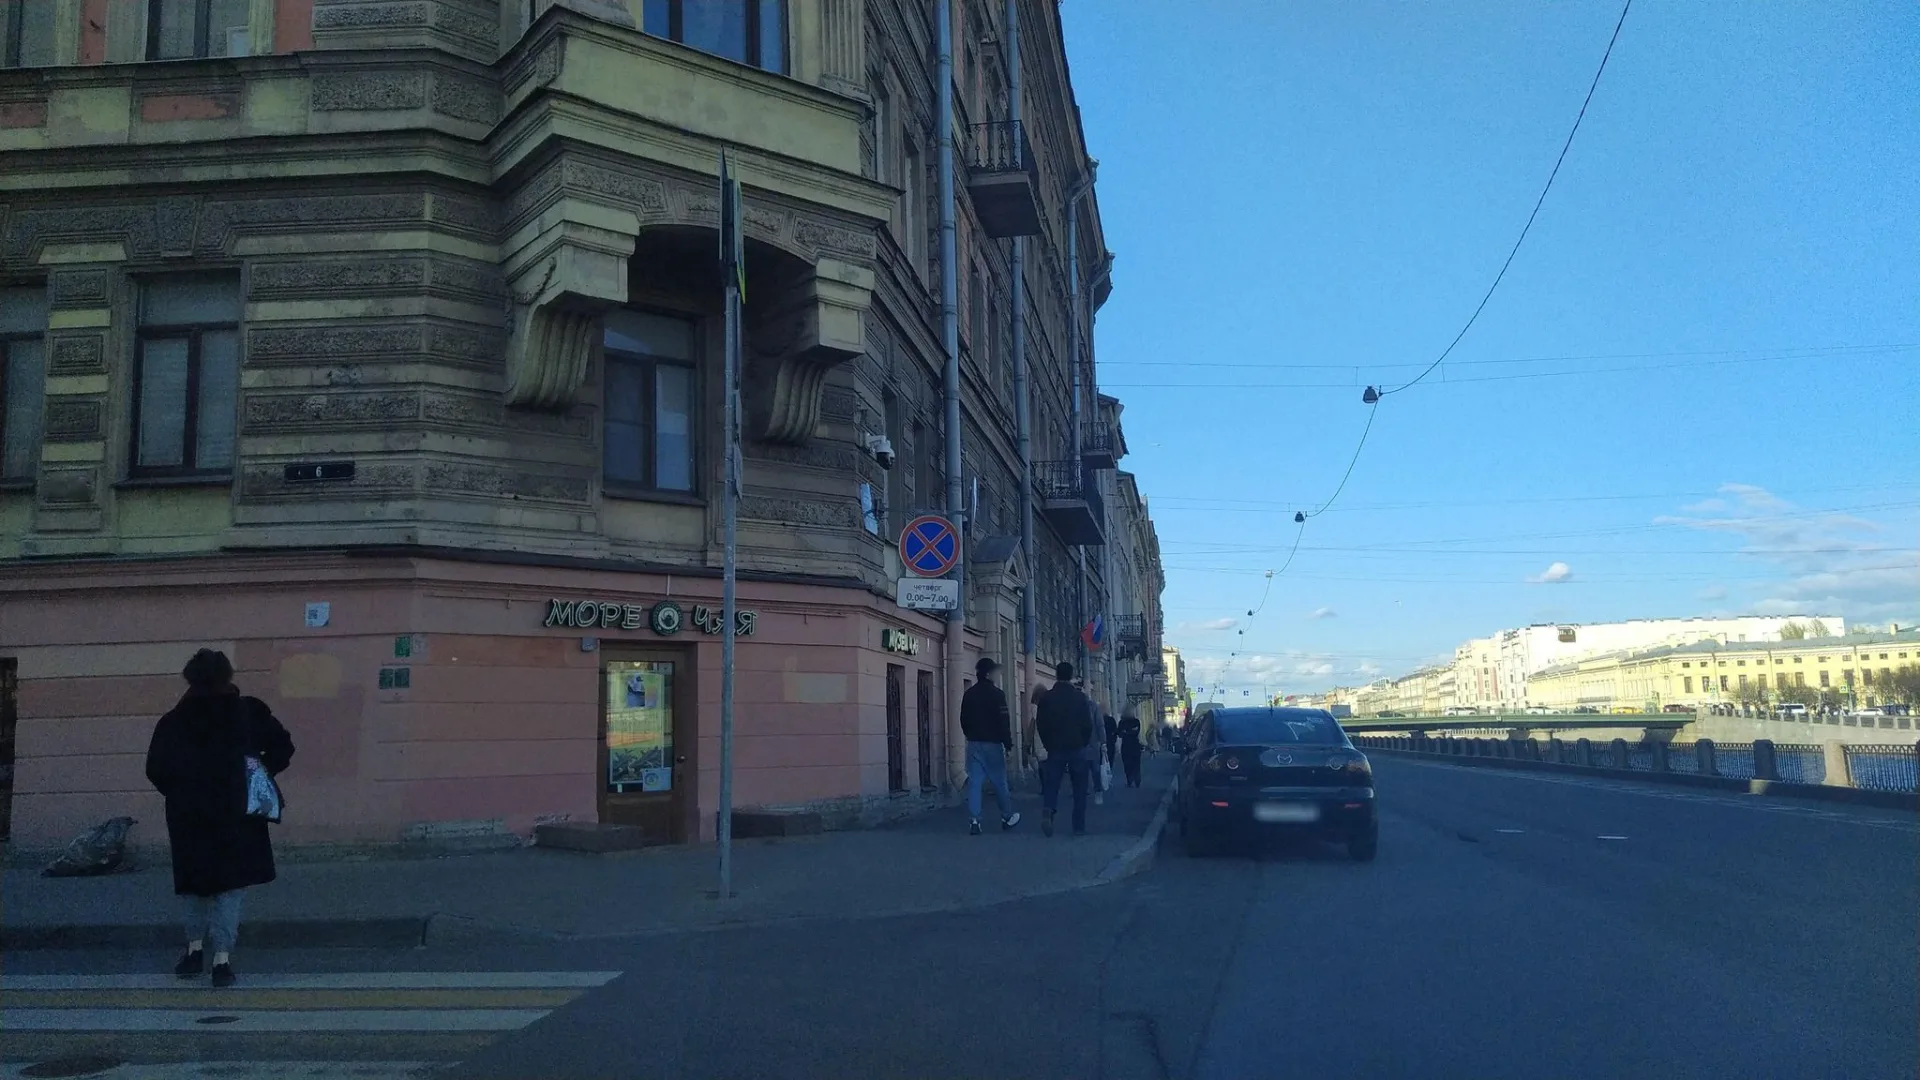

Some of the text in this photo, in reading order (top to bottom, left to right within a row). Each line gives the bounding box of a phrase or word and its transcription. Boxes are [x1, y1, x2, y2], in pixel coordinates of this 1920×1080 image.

[315, 466, 322, 477] 6
[913, 584, 943, 592] четверг
[545, 599, 642, 630] МОРЕ
